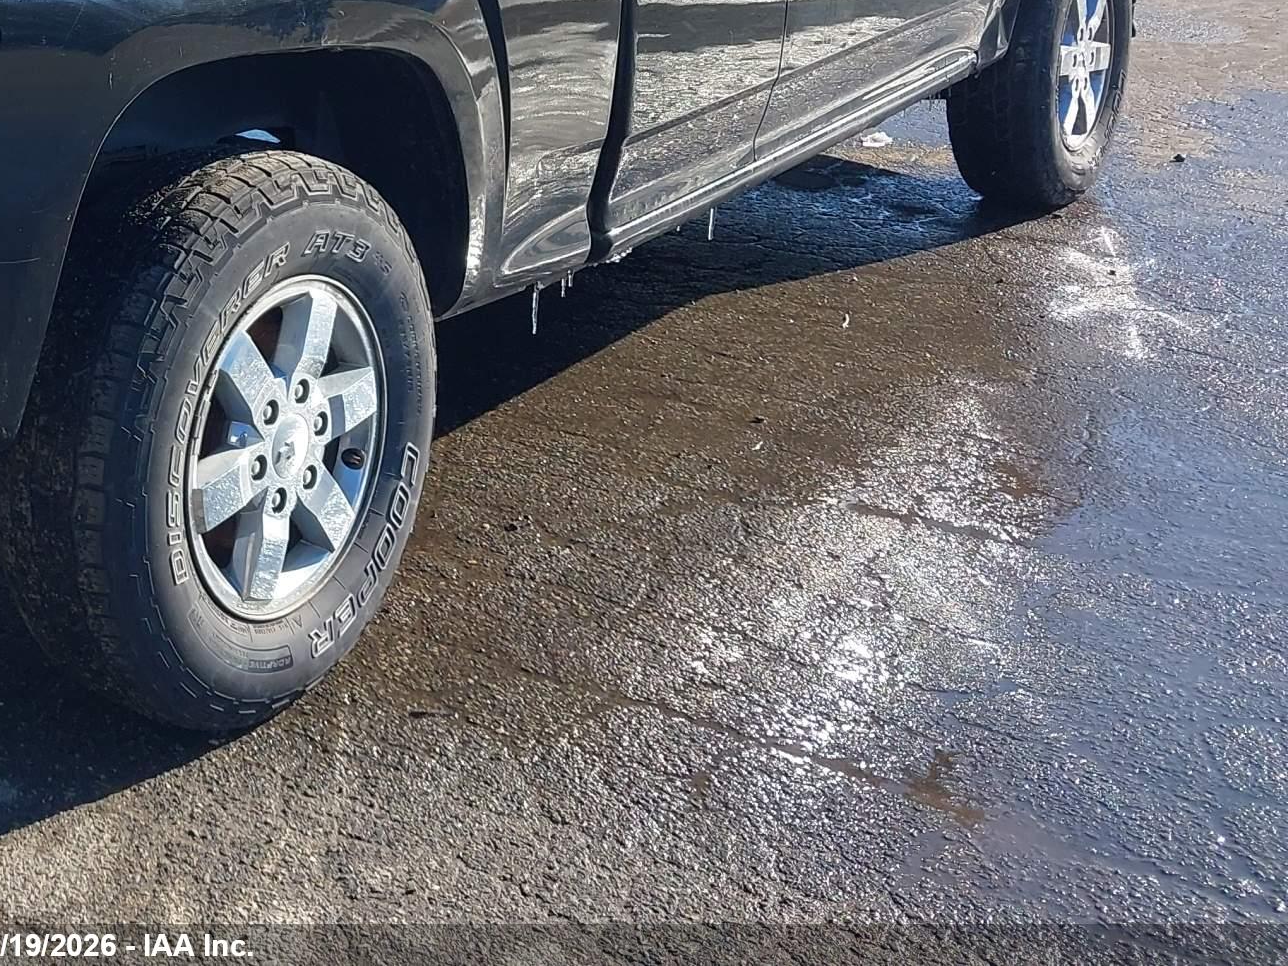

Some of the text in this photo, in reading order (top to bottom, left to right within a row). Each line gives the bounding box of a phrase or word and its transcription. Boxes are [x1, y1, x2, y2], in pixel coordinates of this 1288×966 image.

[166, 241, 290, 586] DISCOVERER
[301, 229, 372, 264] AT3
[308, 441, 421, 659] COOPER
